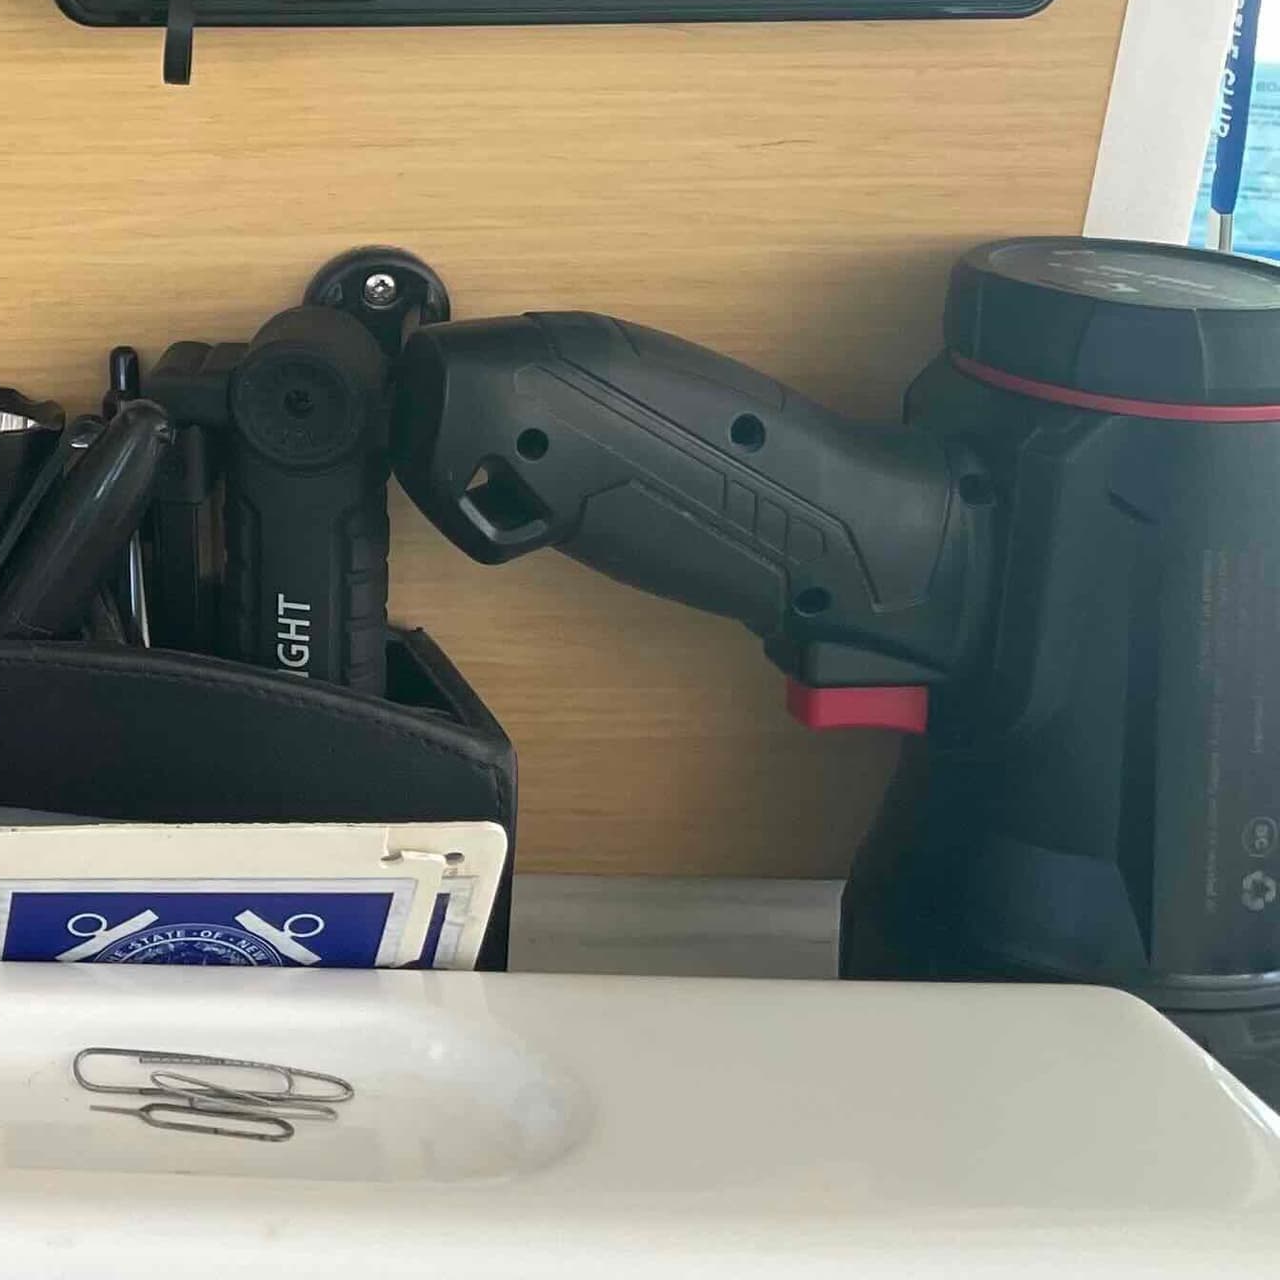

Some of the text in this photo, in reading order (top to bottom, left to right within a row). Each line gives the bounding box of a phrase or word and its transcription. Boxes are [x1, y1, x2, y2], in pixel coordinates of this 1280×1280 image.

[278, 593, 311, 677] IGHT
[130, 930, 269, 961] STATE OF NEW
